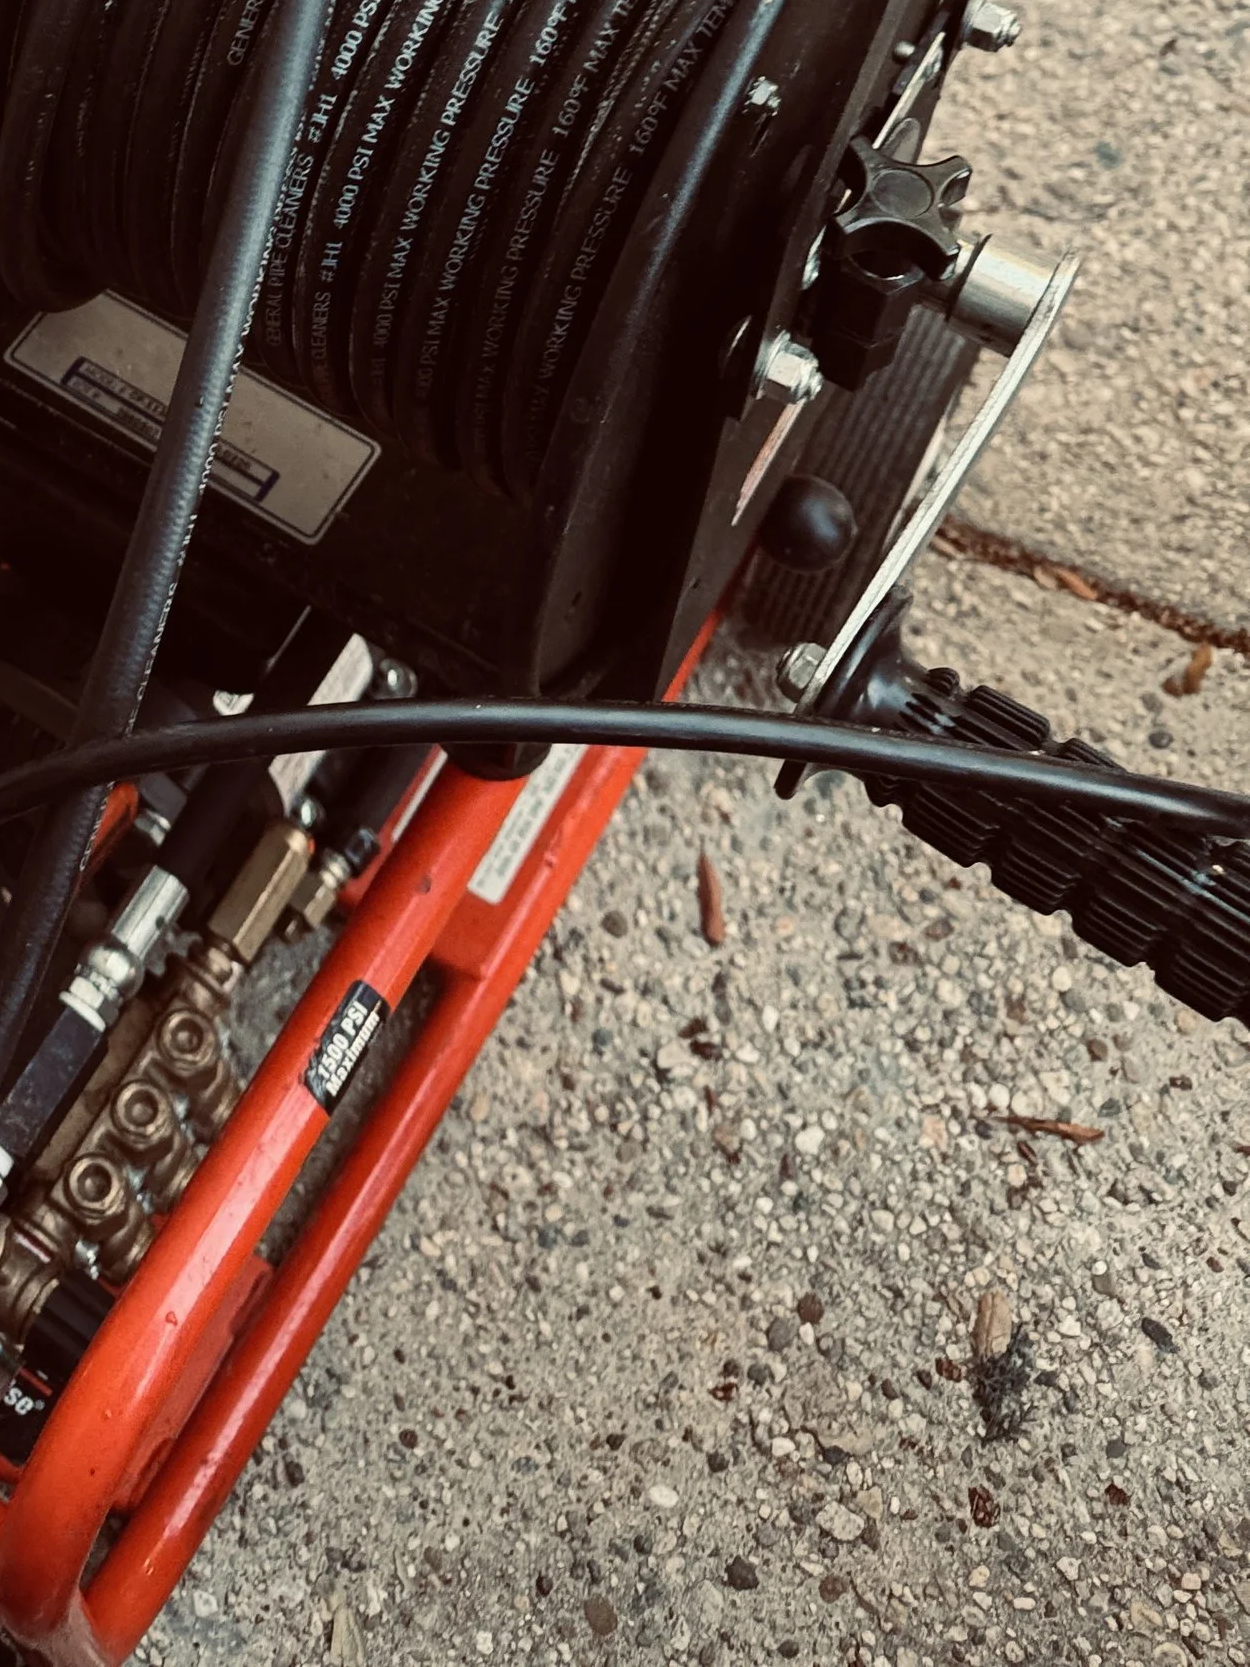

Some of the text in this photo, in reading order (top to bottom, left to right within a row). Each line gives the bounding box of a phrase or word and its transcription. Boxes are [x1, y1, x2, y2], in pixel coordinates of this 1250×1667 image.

[330, 30, 364, 80] 4000
[440, 11, 505, 126] PRESSURE
[307, 94, 339, 144] #JH1
[361, 94, 396, 144] MAX
[474, 74, 536, 191] PRESSURE
[347, 146, 375, 181] PSI
[400, 128, 451, 231] WORKING
[275, 153, 314, 249] CLEANERS
[333, 184, 359, 230] 4000
[481, 264, 521, 359] WORKING
[505, 148, 561, 261] PRESSURE
[582, 21, 622, 74] MAX
[538, 283, 583, 380] WORKING
[570, 164, 636, 281] PRESSURE
[663, 39, 704, 94] MAX
[267, 248, 289, 287] PIPE
[319, 241, 343, 283] #JH1
[387, 236, 414, 279] MAX
[438, 194, 487, 292] WORKING
[379, 282, 401, 310] PSI
[427, 295, 452, 336] MAX
[311, 291, 332, 361] CLEANERS
[372, 313, 395, 349] 4000
[420, 337, 442, 366] PSI
[317, 1000, 368, 1078] 1500 PSI
[326, 1009, 381, 1098] Maximum
